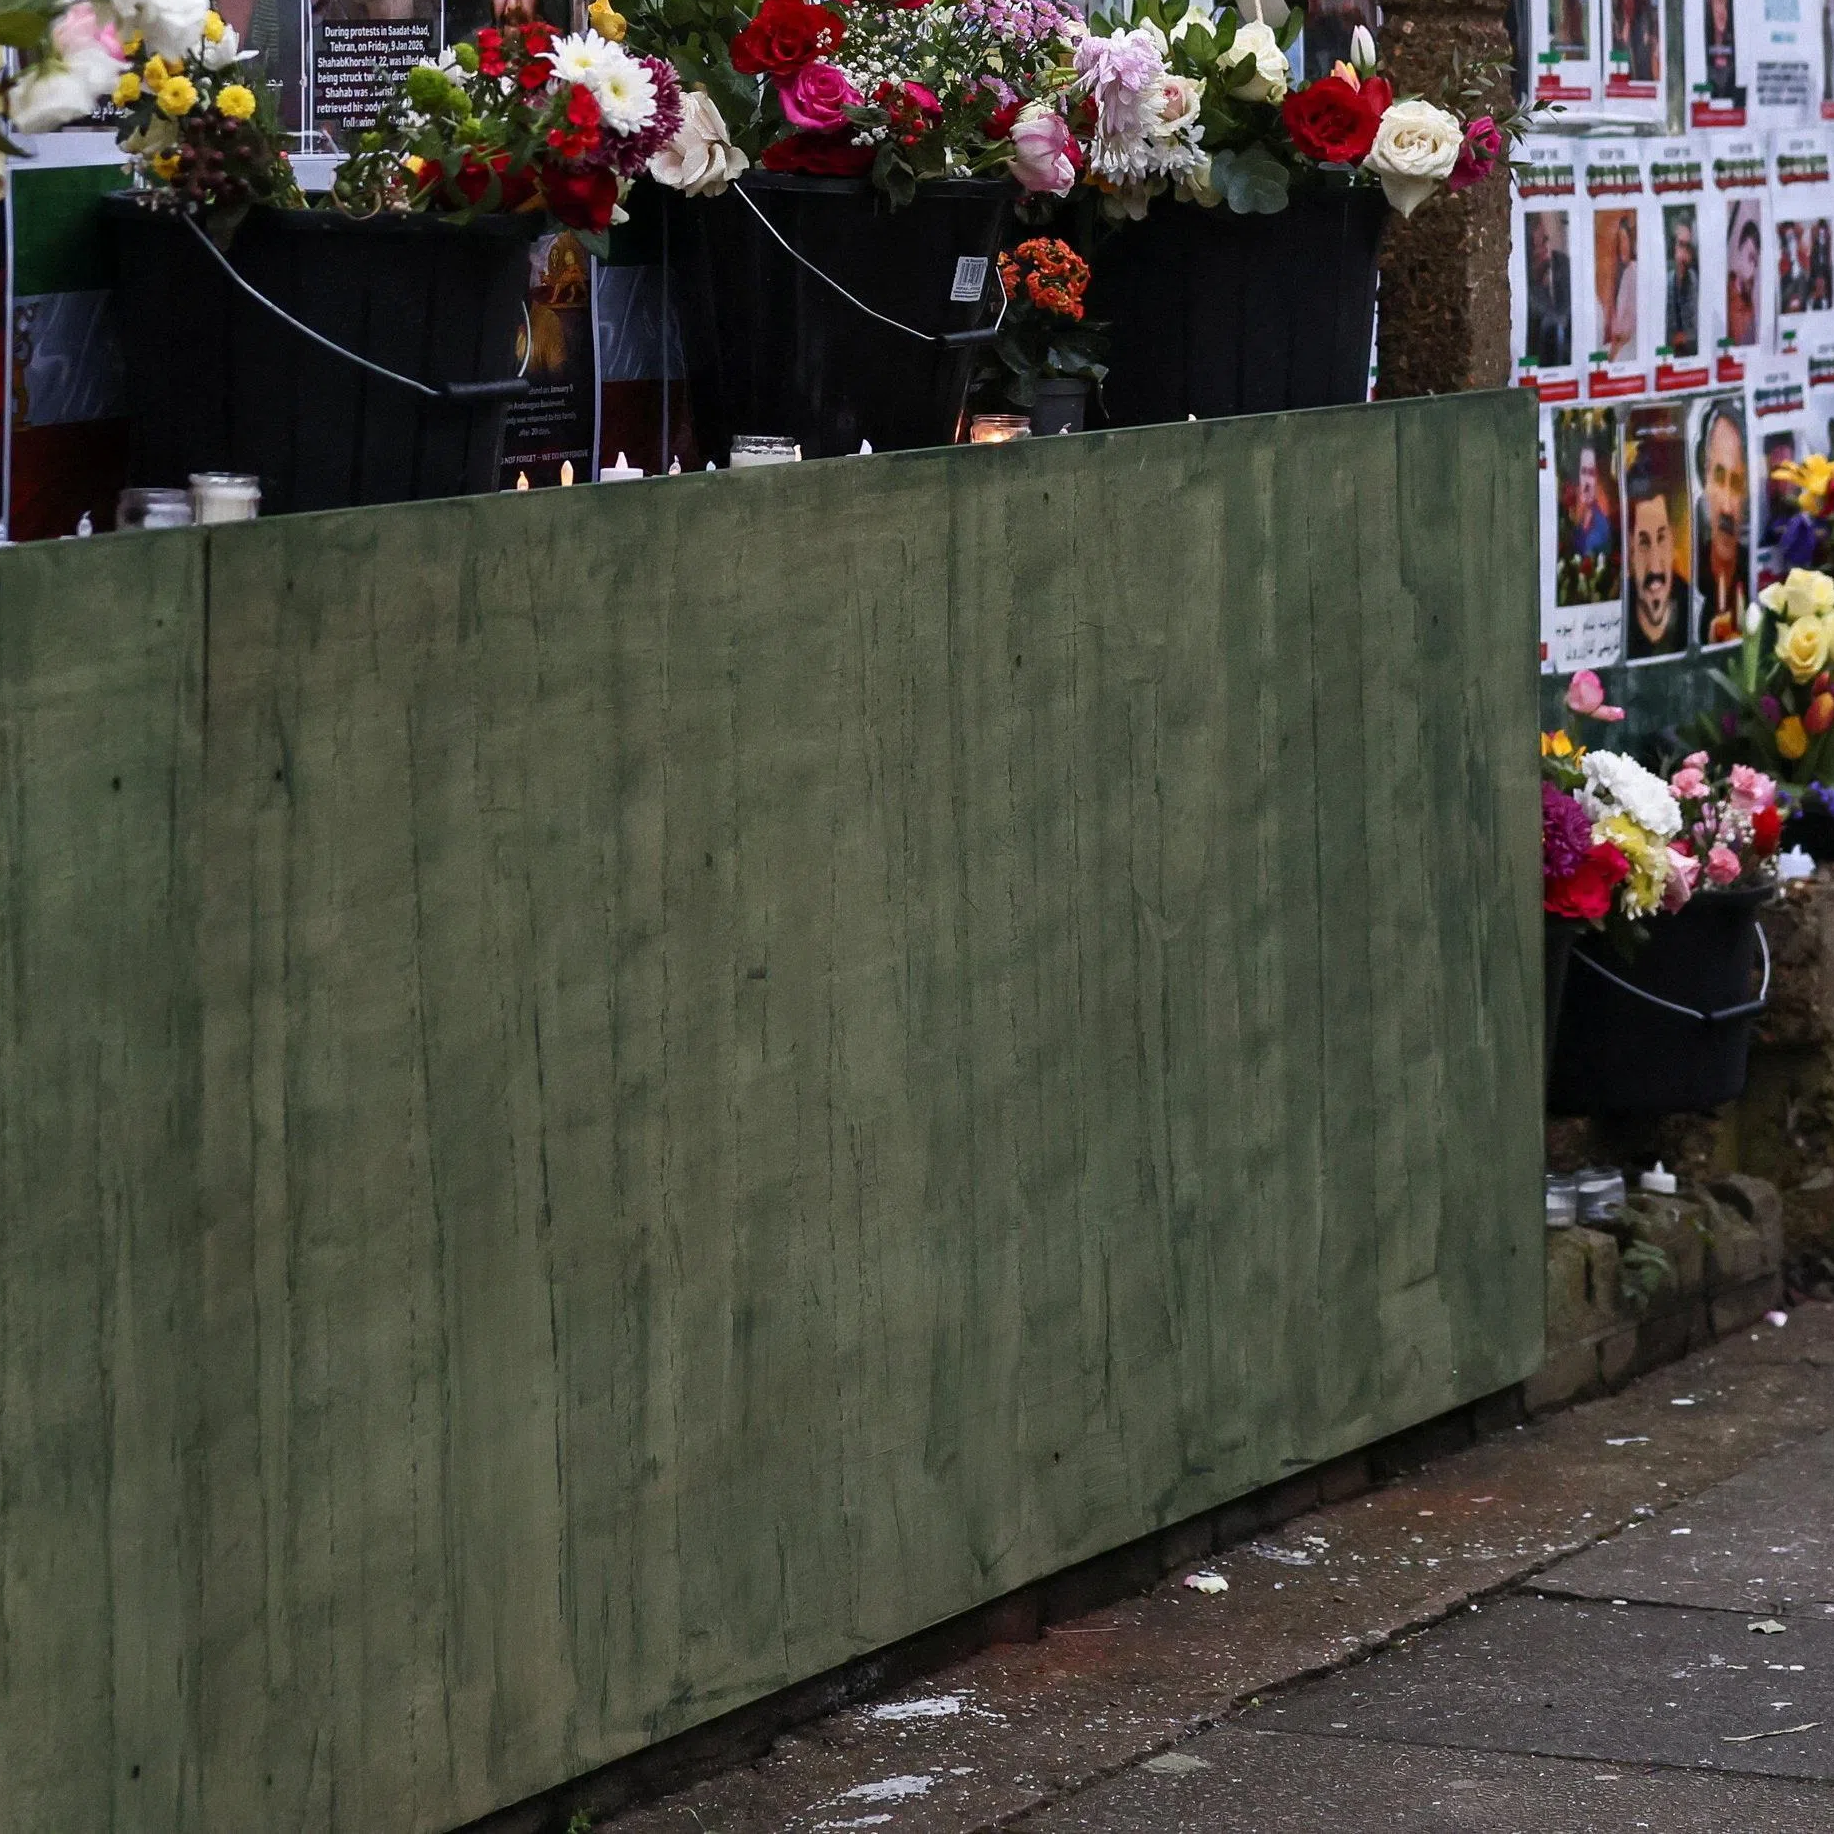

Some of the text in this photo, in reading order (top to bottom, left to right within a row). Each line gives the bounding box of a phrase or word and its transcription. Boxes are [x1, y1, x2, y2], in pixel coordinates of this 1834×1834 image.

[325, 25, 430, 40] During protests in Saadat-Abad,
[330, 40, 425, 53] Tehran, on Friday, 9 Jan 2026,
[379, 56, 388, 68] 22,
[389, 57, 401, 66] was
[402, 55, 418, 65] killed
[317, 72, 363, 85] being struck
[325, 87, 369, 98] Shahab was
[317, 102, 352, 114] retrieved
